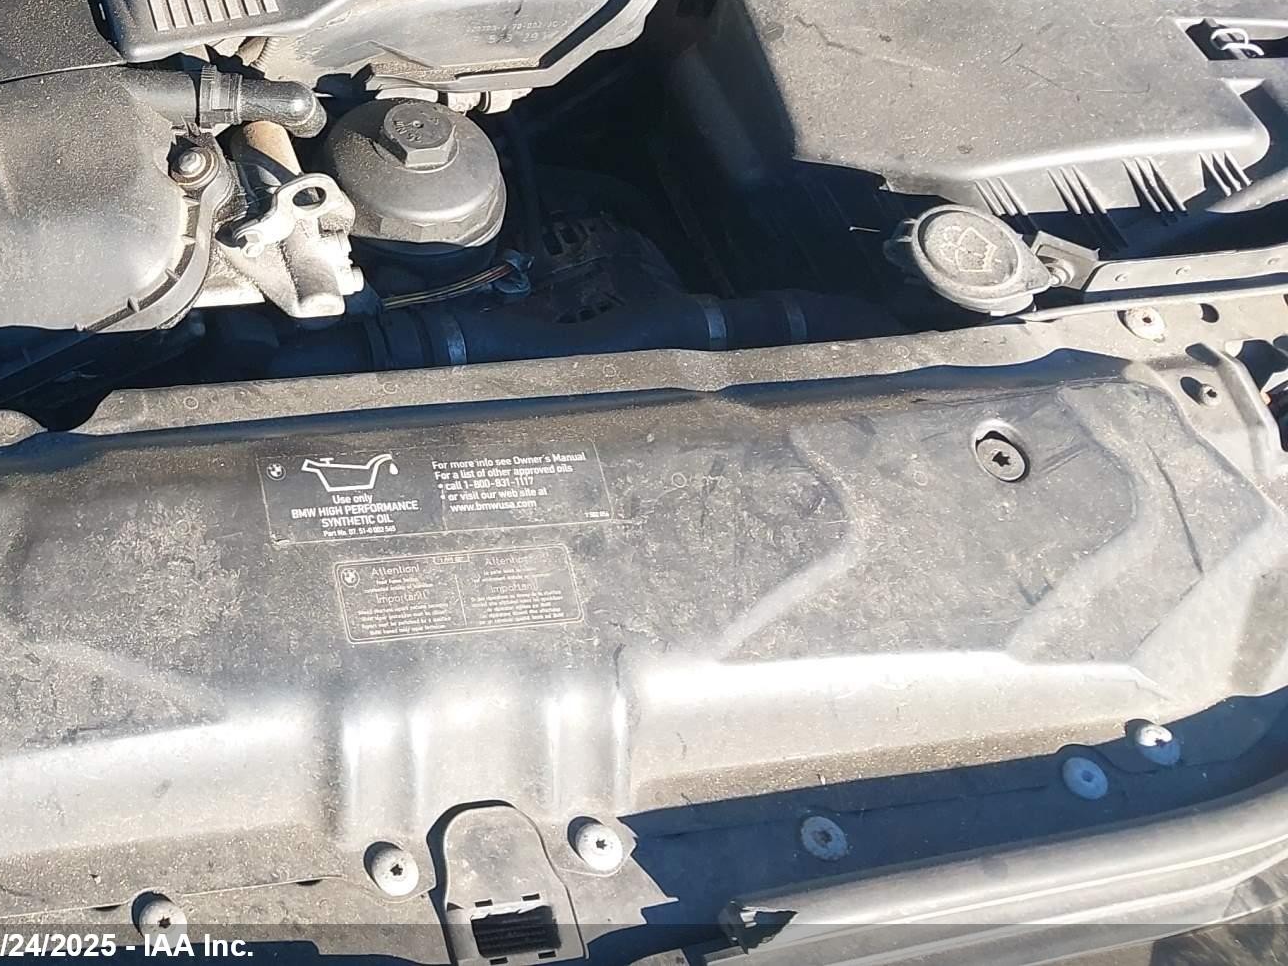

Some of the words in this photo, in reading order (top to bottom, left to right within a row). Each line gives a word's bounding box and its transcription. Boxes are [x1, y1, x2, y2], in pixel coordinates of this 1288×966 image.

[432, 460, 448, 470] For
[449, 459, 474, 469] more
[476, 457, 494, 468] info
[495, 458, 512, 467] see
[513, 454, 550, 465] Owner's
[552, 452, 586, 463] Manual
[435, 471, 450, 481] For
[452, 471, 459, 479] a
[461, 468, 475, 479] list
[477, 468, 486, 478] of
[487, 467, 511, 478] other
[513, 464, 555, 477] approved
[556, 463, 573, 473] oils
[445, 480, 462, 491] call
[463, 477, 534, 489] 1-800-831-1117
[332, 495, 351, 505] Use
[353, 494, 373, 504] only
[448, 493, 458, 501] or
[460, 490, 479, 501] visit
[482, 491, 496, 500] our
[498, 489, 518, 499] web
[519, 488, 537, 498] site
[538, 487, 548, 496] at
[291, 508, 316, 519] BMW
[319, 506, 343, 517] HIGH
[345, 500, 419, 515] PERFORMANCE
[450, 500, 537, 512] www.bmwusa.com
[321, 515, 375, 528] SYNTHETIC
[377, 514, 394, 524] OIL
[372, 564, 420, 577] Attention!
[376, 591, 427, 604] Important!
